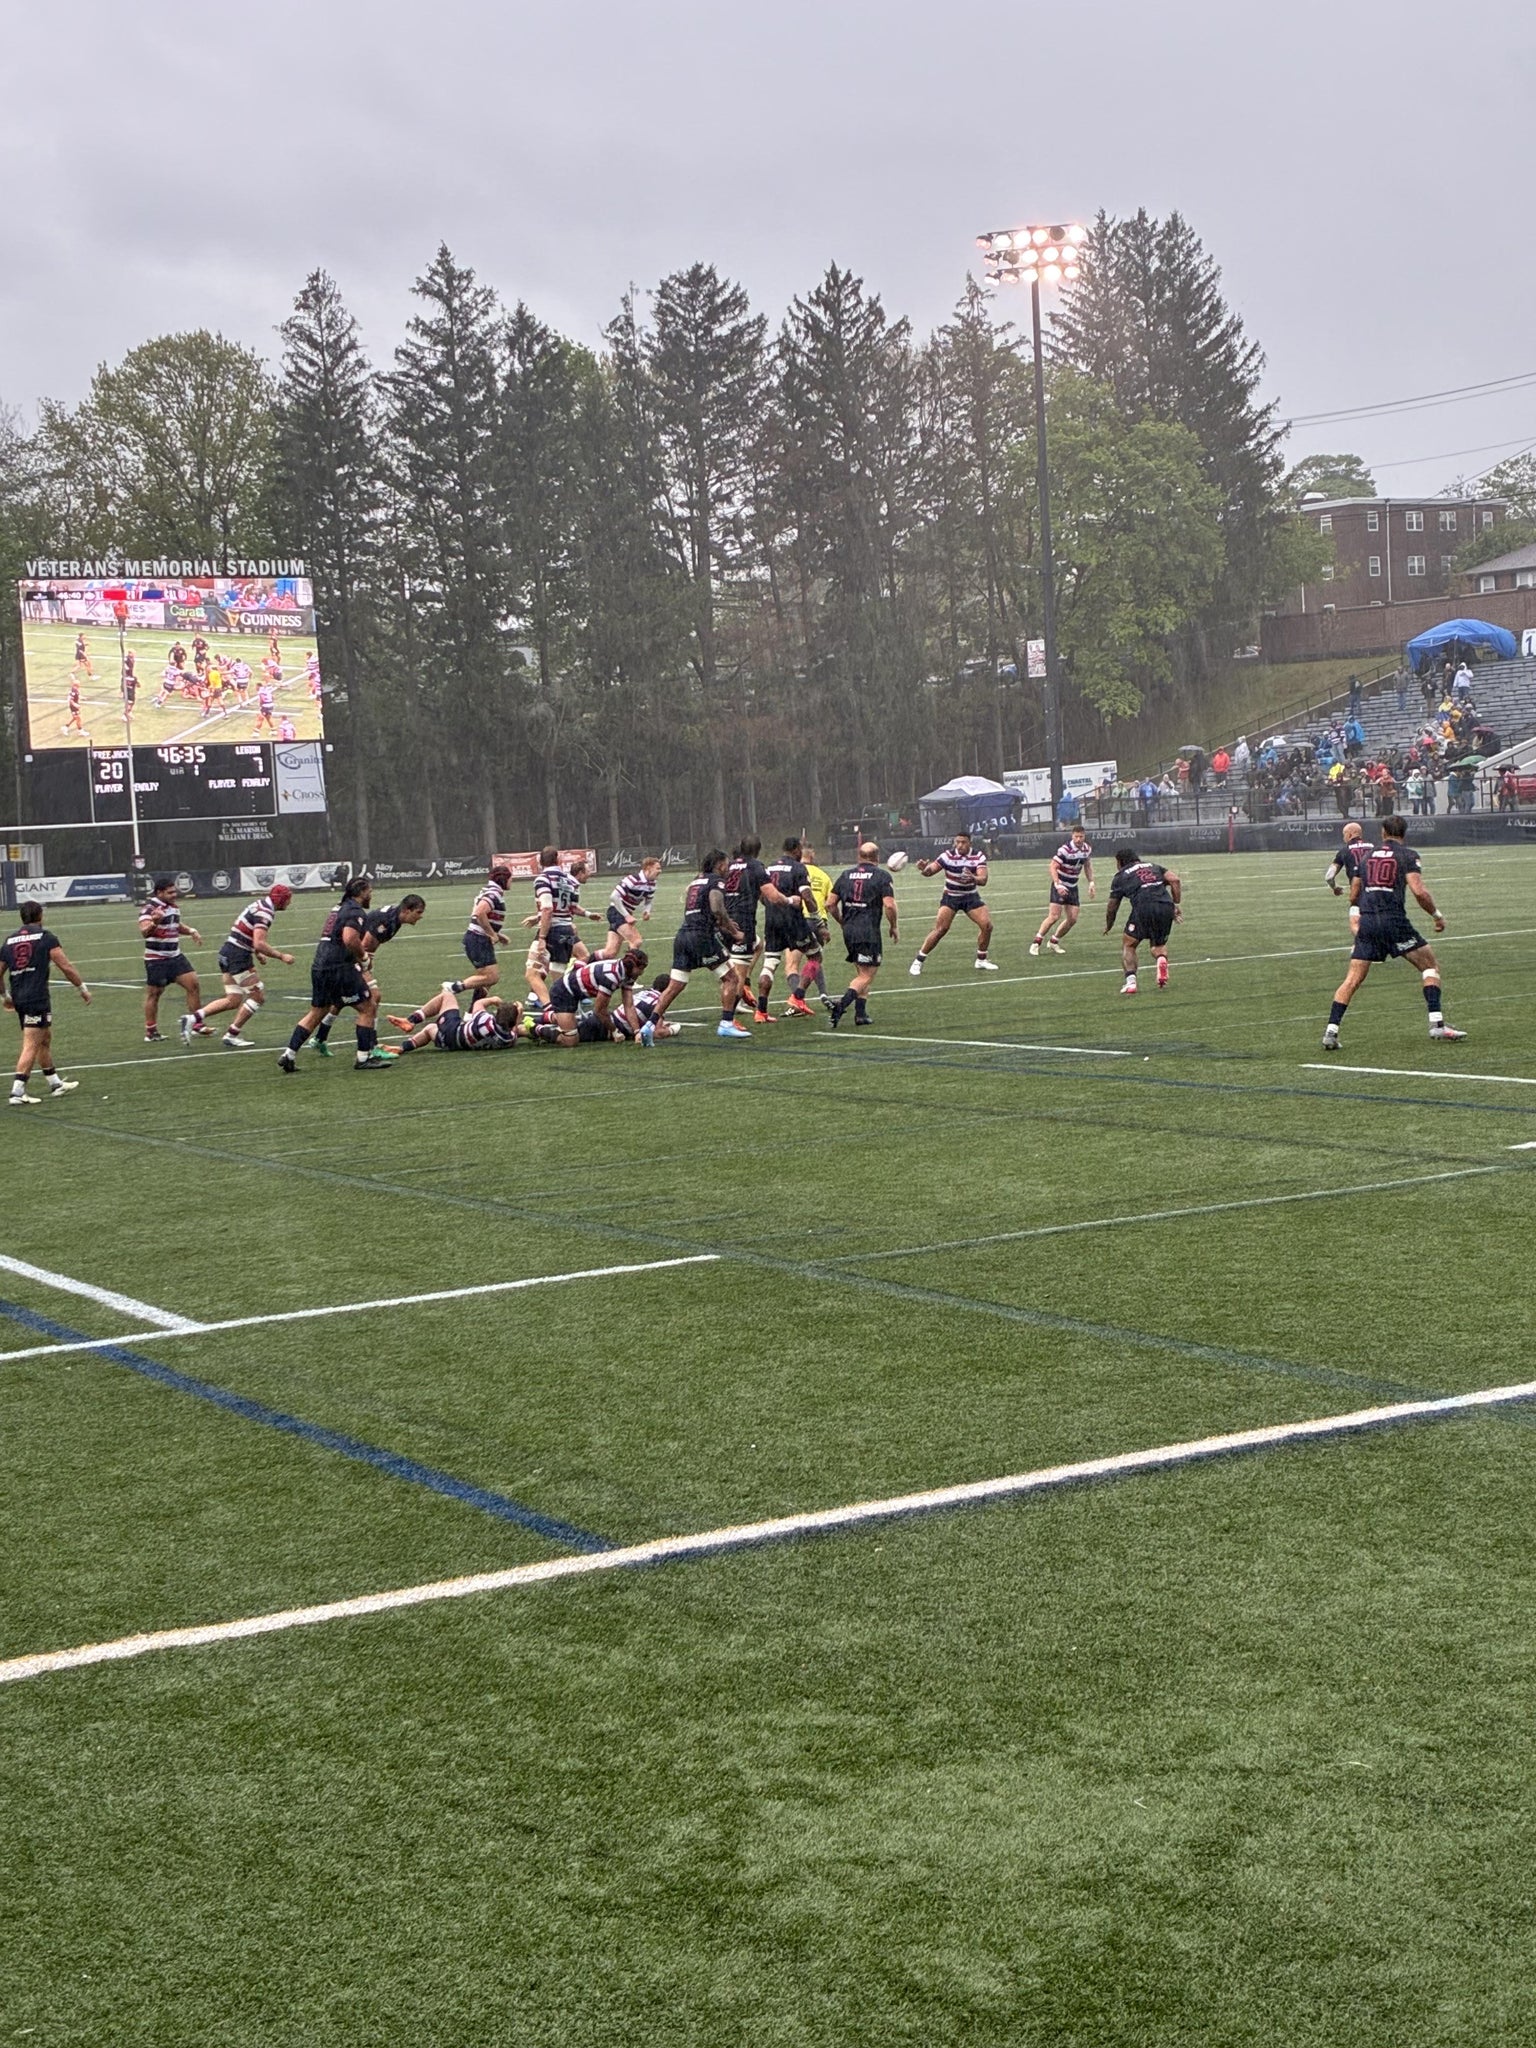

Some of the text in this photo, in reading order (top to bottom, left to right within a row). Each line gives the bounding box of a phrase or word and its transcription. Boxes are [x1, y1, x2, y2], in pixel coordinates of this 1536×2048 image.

[26, 559, 305, 577] VETERANS MEMORIAL STADIUM
[240, 612, 302, 627] GUINNESS
[157, 746, 206, 764] 46:35
[100, 762, 123, 780] 20
[252, 757, 263, 773] 7
[375, 863, 394, 872] Alloy
[444, 861, 463, 870] Alloy
[444, 866, 489, 876] Therapeutics
[1367, 859, 1398, 886] 10
[375, 870, 422, 879] Therapeutics
[15, 881, 57, 893] GIANT
